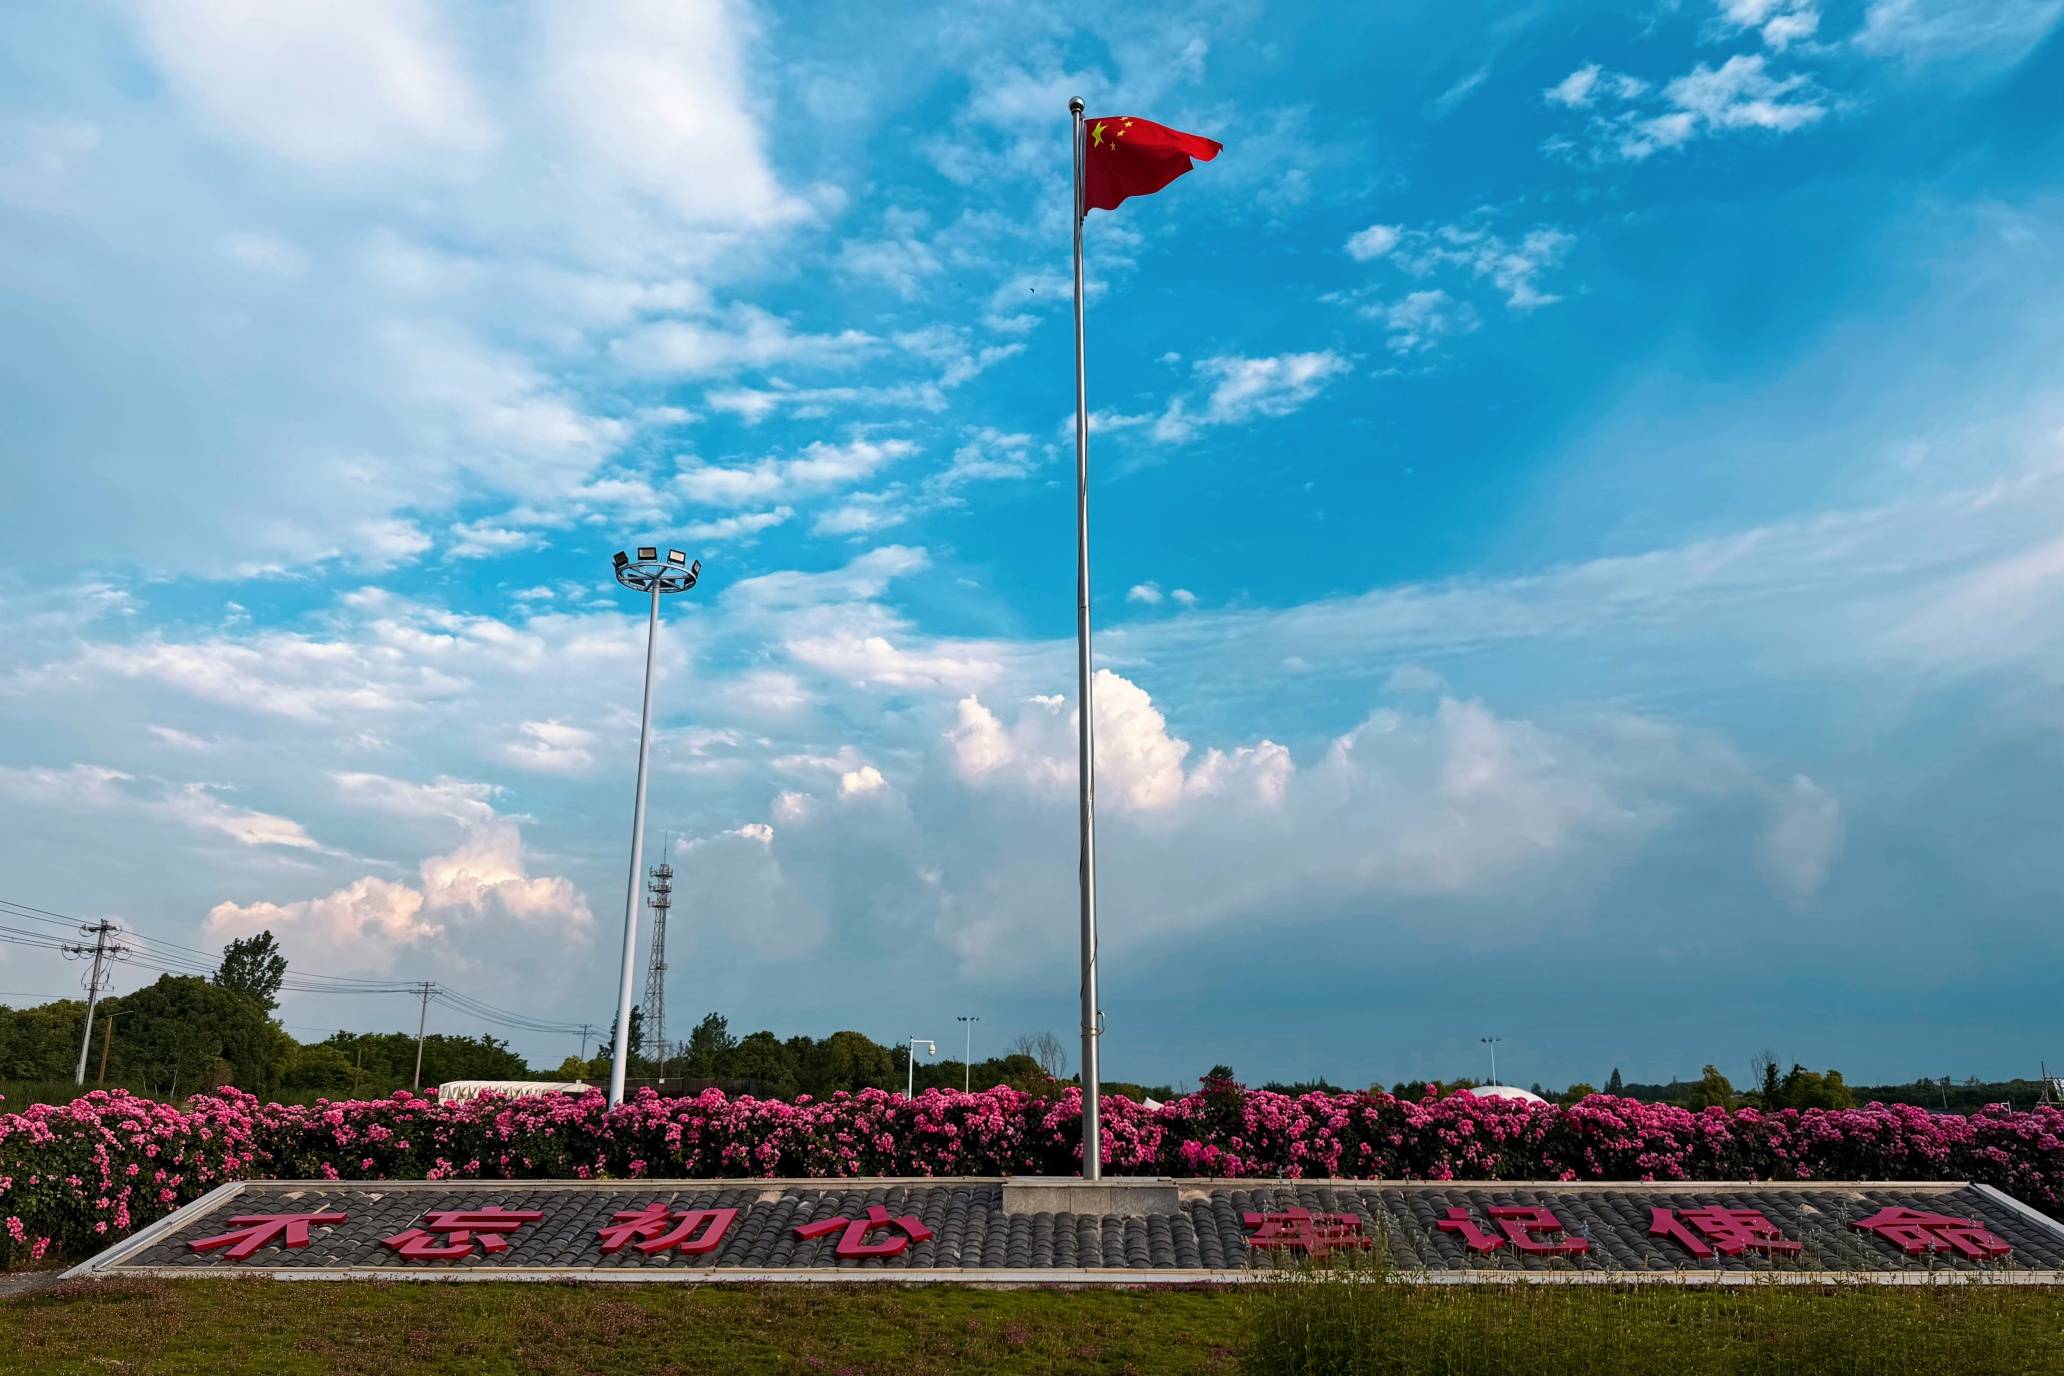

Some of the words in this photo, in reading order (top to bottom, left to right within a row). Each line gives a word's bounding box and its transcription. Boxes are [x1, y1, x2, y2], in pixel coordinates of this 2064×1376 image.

[188, 1204, 933, 1259] 不忘初心
[1243, 1206, 2011, 1259] 牢记使命
